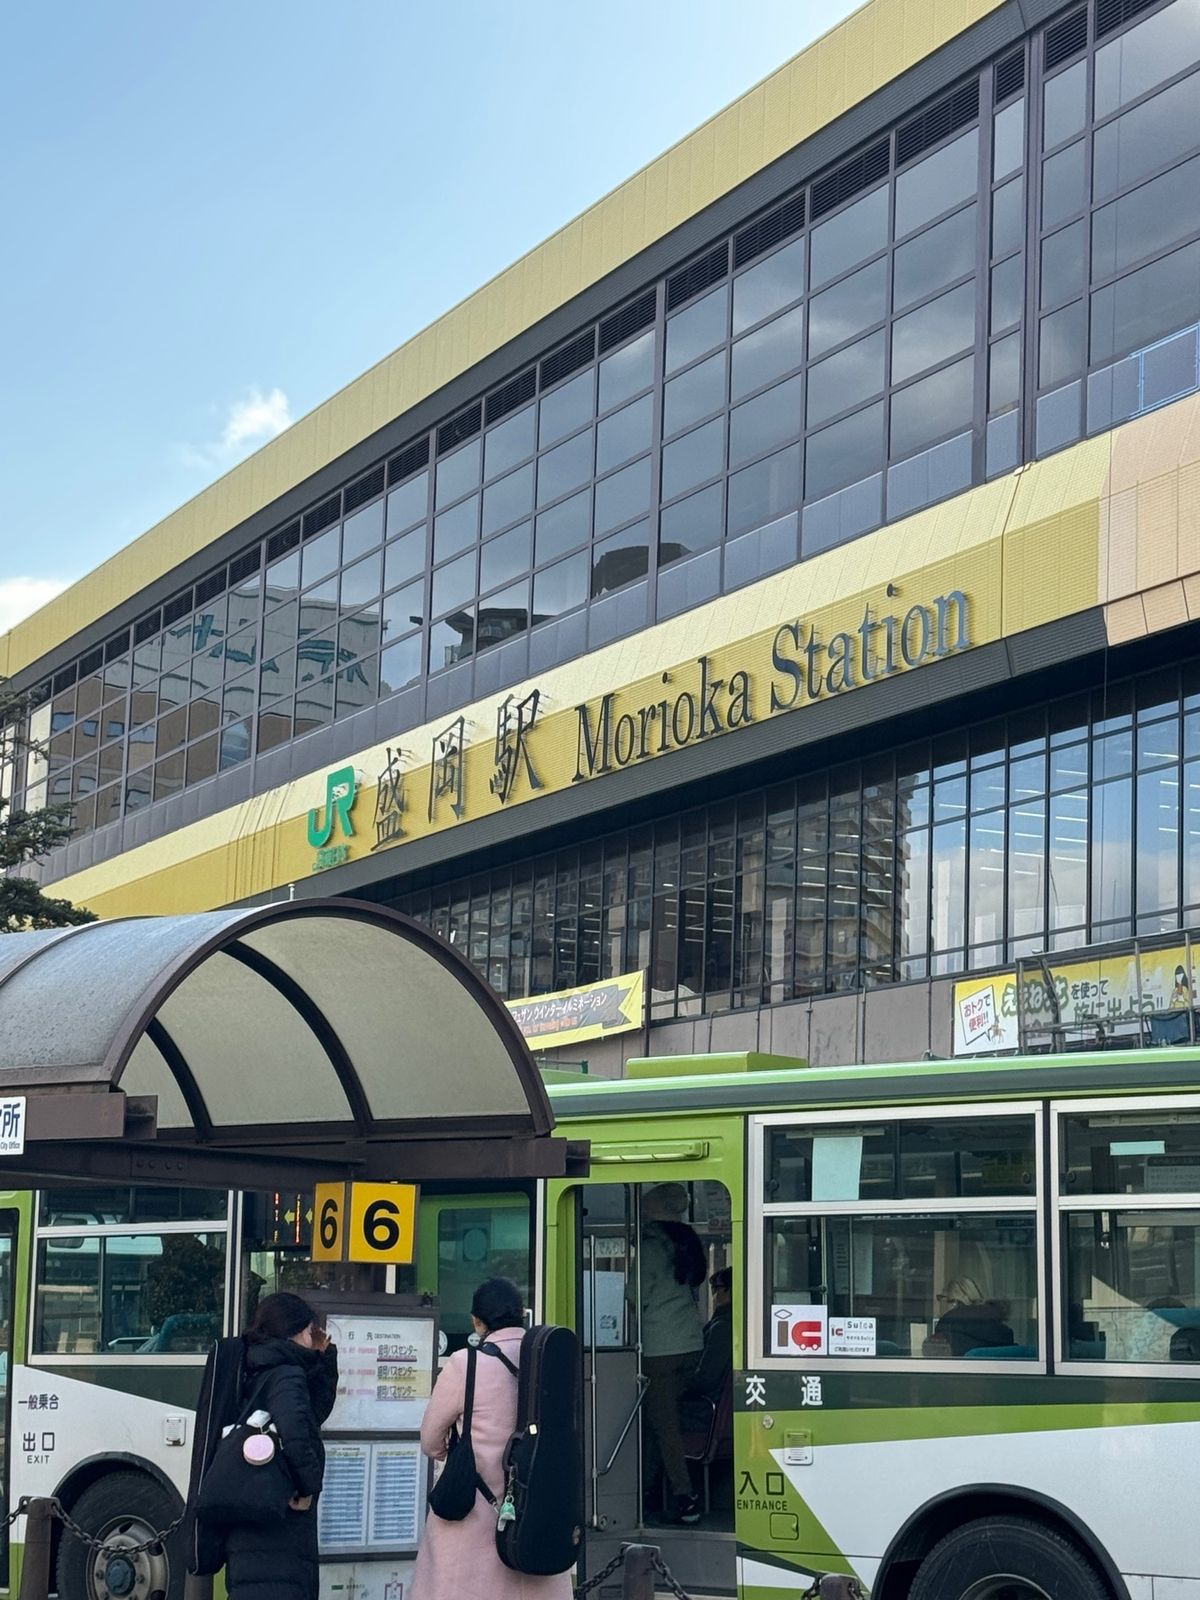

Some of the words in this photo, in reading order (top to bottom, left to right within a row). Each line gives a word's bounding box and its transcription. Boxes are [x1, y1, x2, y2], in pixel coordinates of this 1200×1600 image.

[372, 688, 543, 851] 盛岡駅
[572, 657, 752, 781] Morioka
[770, 584, 970, 714] Station
[307, 764, 355, 848] JR
[320, 1199, 338, 1248] 6
[363, 1200, 400, 1250] 6
[18, 1394, 59, 1410] 一般乗合
[746, 1375, 823, 1406] 交通
[23, 1432, 55, 1451] 出口
[27, 1454, 50, 1464] EXIT
[739, 1471, 784, 1495] 入口
[737, 1499, 788, 1511] ENTRANCE
